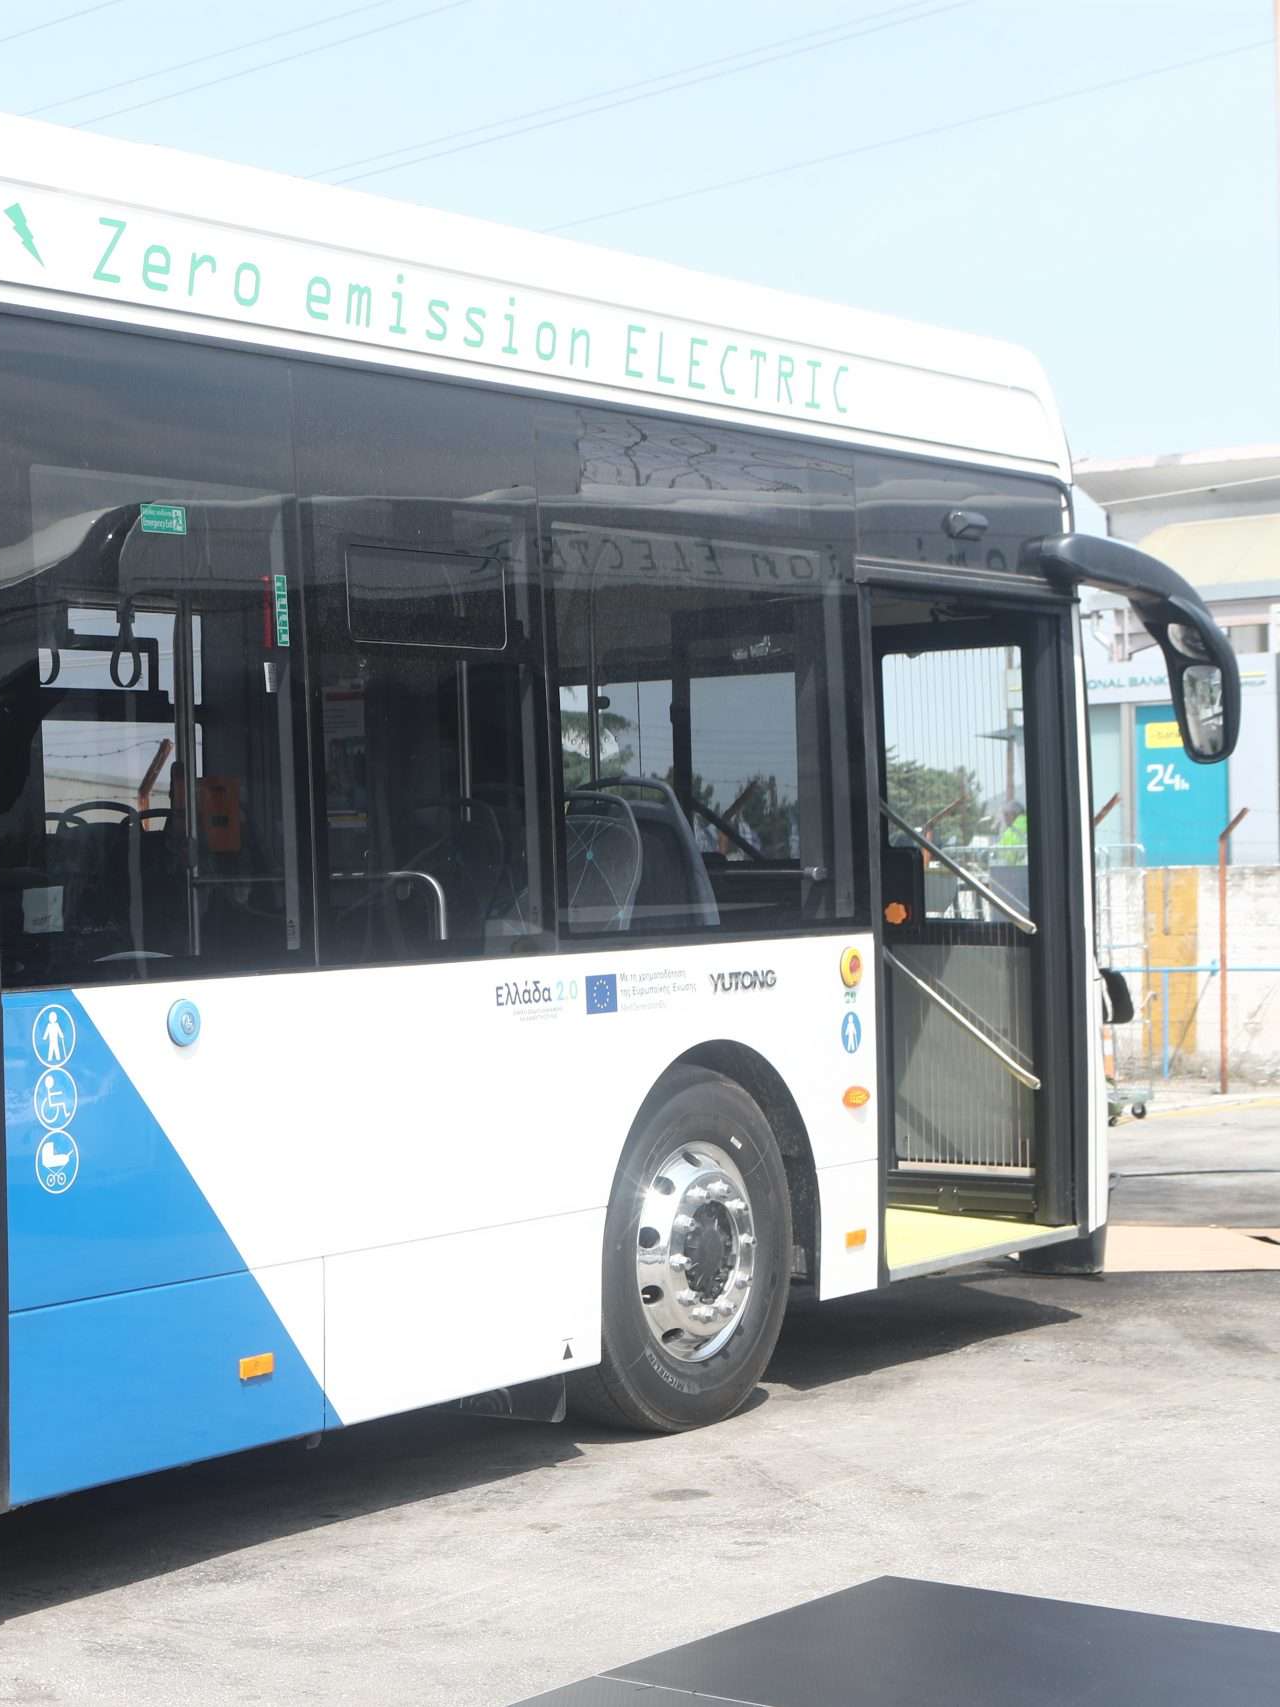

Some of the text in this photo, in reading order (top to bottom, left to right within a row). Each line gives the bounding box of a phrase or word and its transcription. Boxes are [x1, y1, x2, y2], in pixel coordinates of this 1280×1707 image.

[93, 217, 851, 414] Zero emission ELECTRIC
[495, 980, 579, 1007] Ελλάδα 2.0
[709, 969, 777, 993] YUTONG
